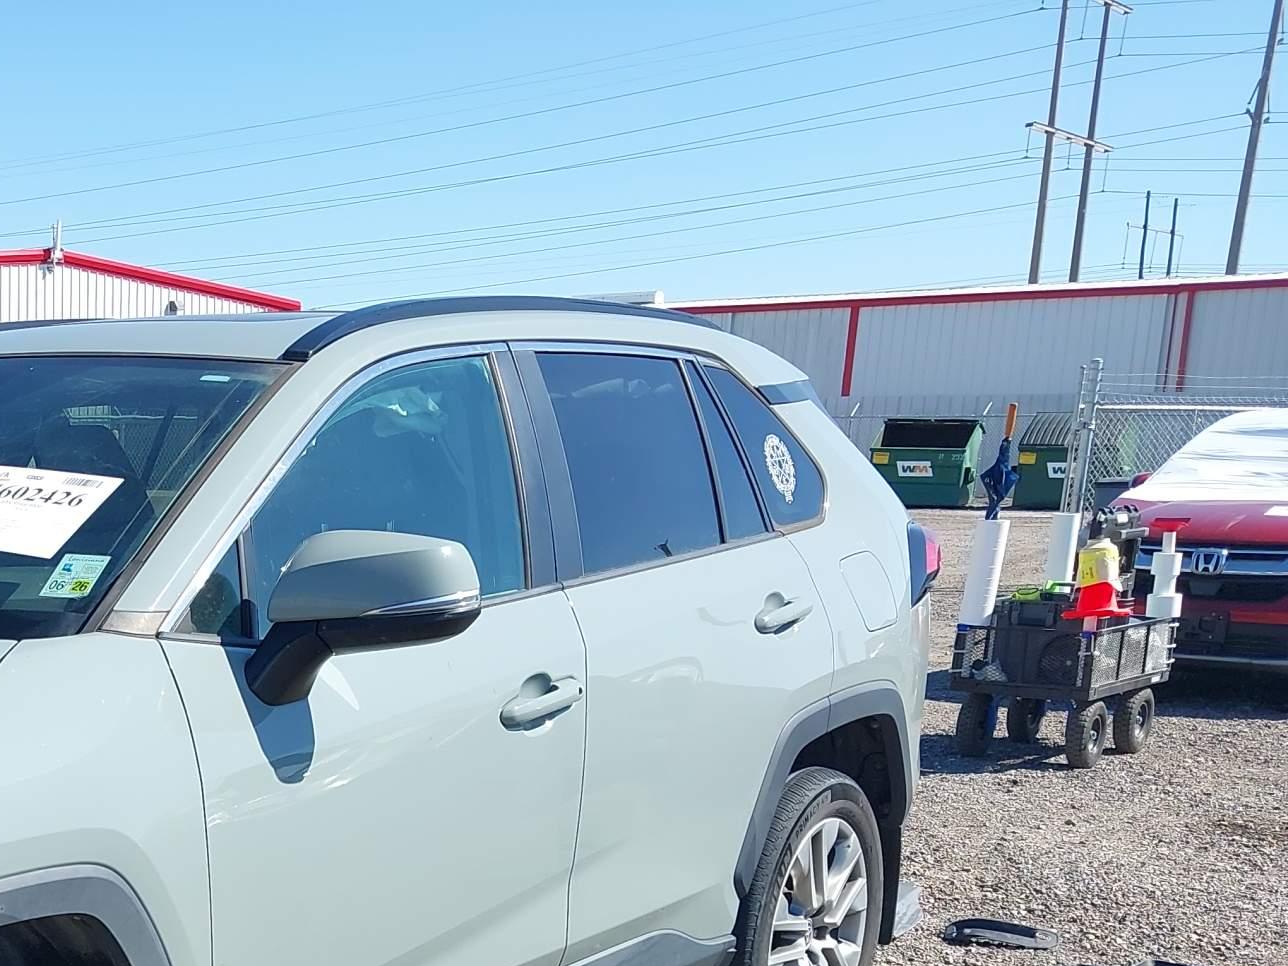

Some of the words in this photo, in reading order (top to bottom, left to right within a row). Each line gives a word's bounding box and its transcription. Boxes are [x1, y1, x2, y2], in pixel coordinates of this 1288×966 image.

[902, 465, 929, 473] WM
[49, 580, 66, 591] 06
[72, 580, 90, 592] 26
